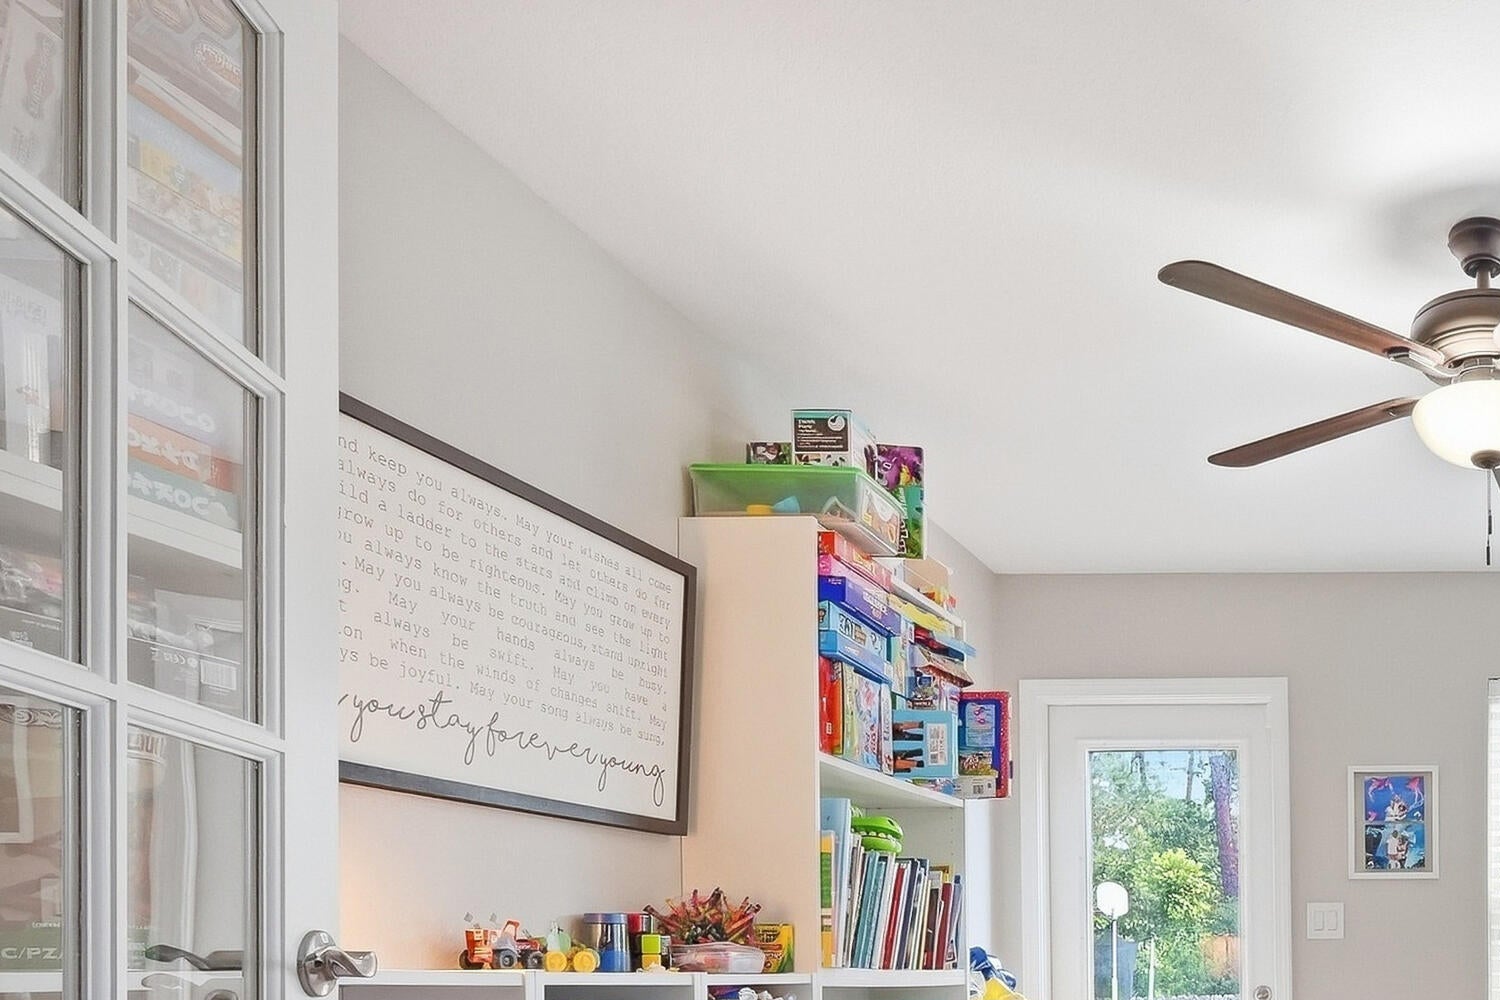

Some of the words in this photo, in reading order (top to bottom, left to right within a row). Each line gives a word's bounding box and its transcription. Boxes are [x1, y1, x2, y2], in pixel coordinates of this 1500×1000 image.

[338, 459, 397, 493] always
[408, 488, 426, 506] do
[438, 501, 464, 522] for
[473, 518, 522, 547] others
[531, 543, 554, 561] and
[561, 554, 582, 573] let
[590, 568, 629, 593] others
[368, 446, 408, 477] keep
[416, 470, 443, 491] you
[516, 514, 539, 537] May
[546, 529, 575, 549] your
[625, 565, 643, 582] all
[378, 499, 387, 512] a
[398, 503, 452, 538] ladder
[461, 532, 477, 548] to
[485, 543, 509, 561] the
[516, 556, 553, 579] stars
[624, 602, 637, 613] on
[354, 556, 385, 581] May
[394, 573, 421, 591] you
[430, 586, 481, 613] always
[488, 603, 505, 621] be
[364, 539, 422, 570] always
[433, 562, 468, 586] know
[477, 579, 501, 598] the
[510, 592, 547, 617] truth
[555, 610, 577, 627] and
[585, 623, 605, 638] see
[613, 631, 632, 648] the
[385, 524, 404, 542] up
[415, 535, 432, 551] to
[442, 543, 460, 562] be
[469, 557, 546, 596] righteous.
[554, 589, 577, 609] May
[583, 602, 603, 618] you
[609, 613, 635, 631] grow
[640, 625, 653, 639] up
[658, 631, 671, 644] to
[388, 591, 418, 614] May
[441, 611, 476, 631] your
[497, 627, 536, 651] hands
[554, 649, 596, 672] always
[611, 667, 625, 681] be
[338, 624, 363, 641] on
[390, 638, 428, 660] when
[440, 652, 465, 670] the
[476, 664, 517, 685] winds
[526, 678, 542, 692] of
[550, 686, 598, 709] changes
[606, 703, 641, 722] shift.
[369, 653, 389, 670] be
[400, 661, 460, 690] joyful.
[470, 681, 495, 701] May
[503, 692, 533, 709] your
[540, 702, 569, 721] song
[575, 711, 615, 732] always
[620, 723, 633, 736] be
[373, 611, 430, 638] always
[452, 633, 469, 650] be
[489, 648, 534, 671] swift.
[553, 666, 575, 686] May
[591, 679, 610, 694] you
[624, 688, 649, 706] have
[350, 694, 415, 743] you
[416, 690, 484, 766] stay
[486, 711, 599, 761] forever
[598, 752, 666, 807] young
